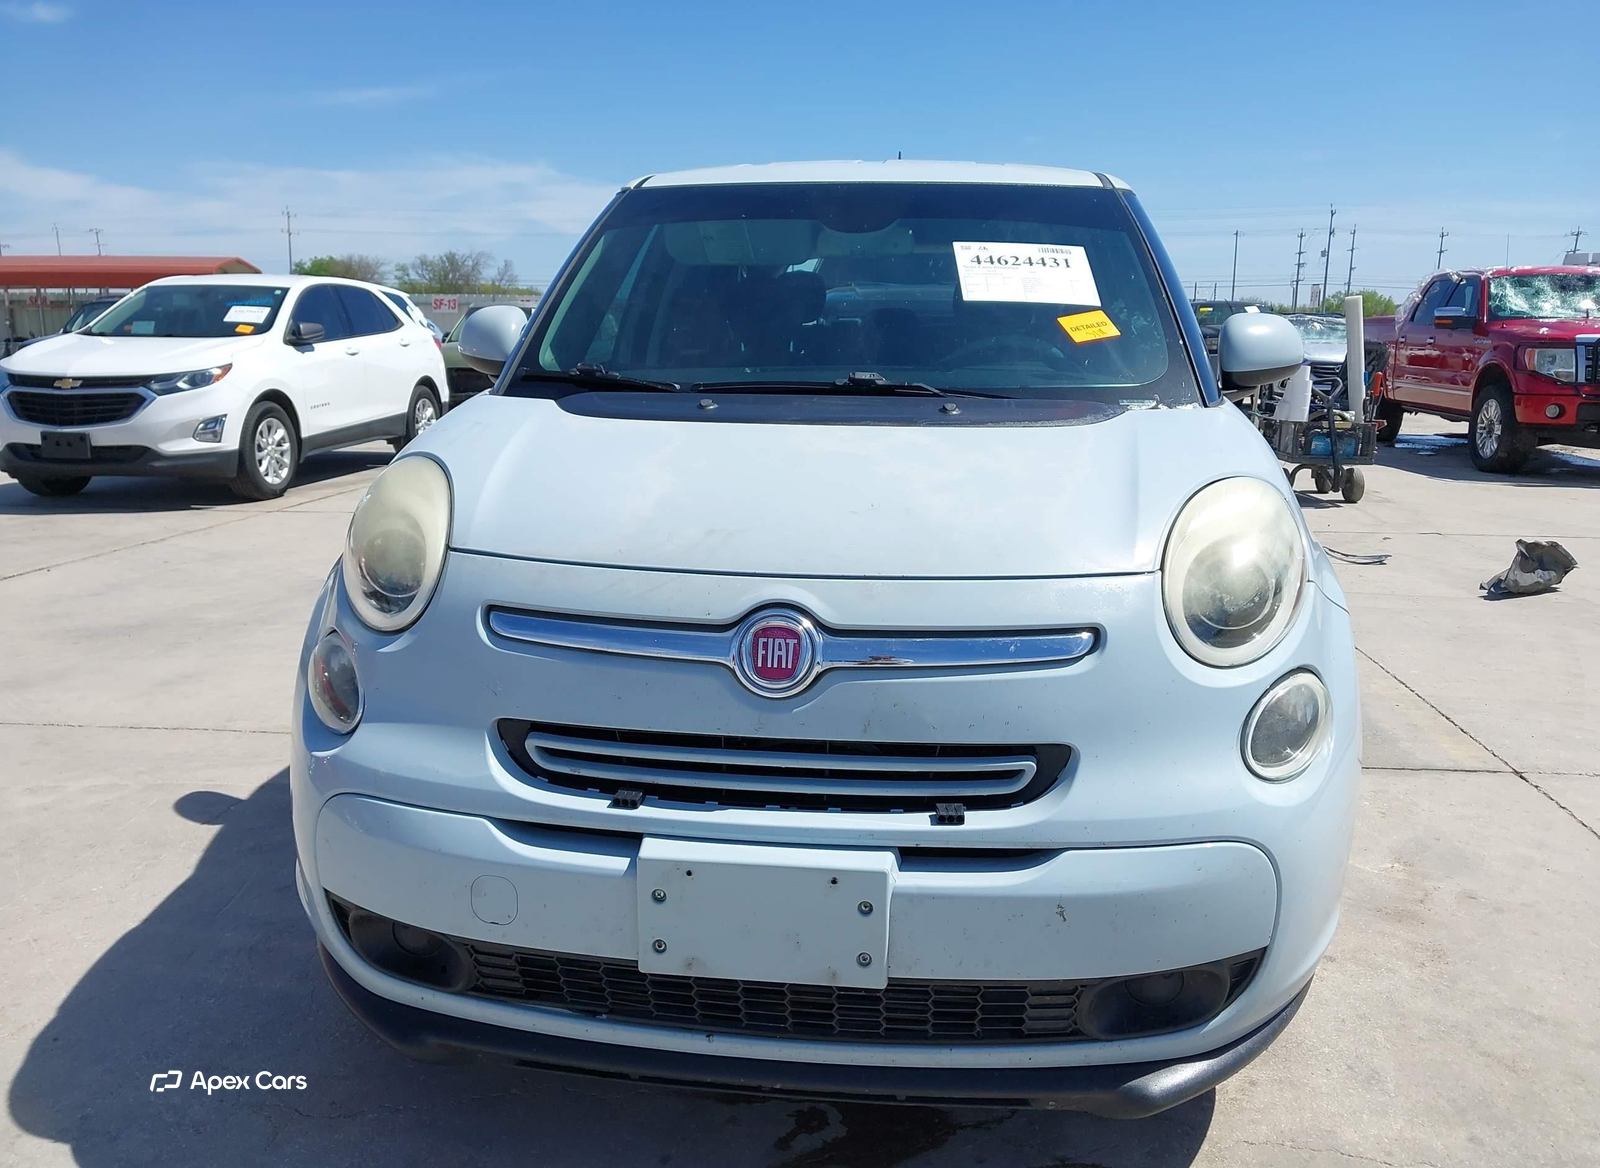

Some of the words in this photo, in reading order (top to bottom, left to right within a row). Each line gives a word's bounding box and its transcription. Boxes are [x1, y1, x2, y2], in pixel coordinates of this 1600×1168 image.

[970, 254, 1072, 269] 44624431
[432, 298, 457, 310] SF-13
[1069, 320, 1108, 333] DETAILED
[757, 637, 798, 669] FIAT
